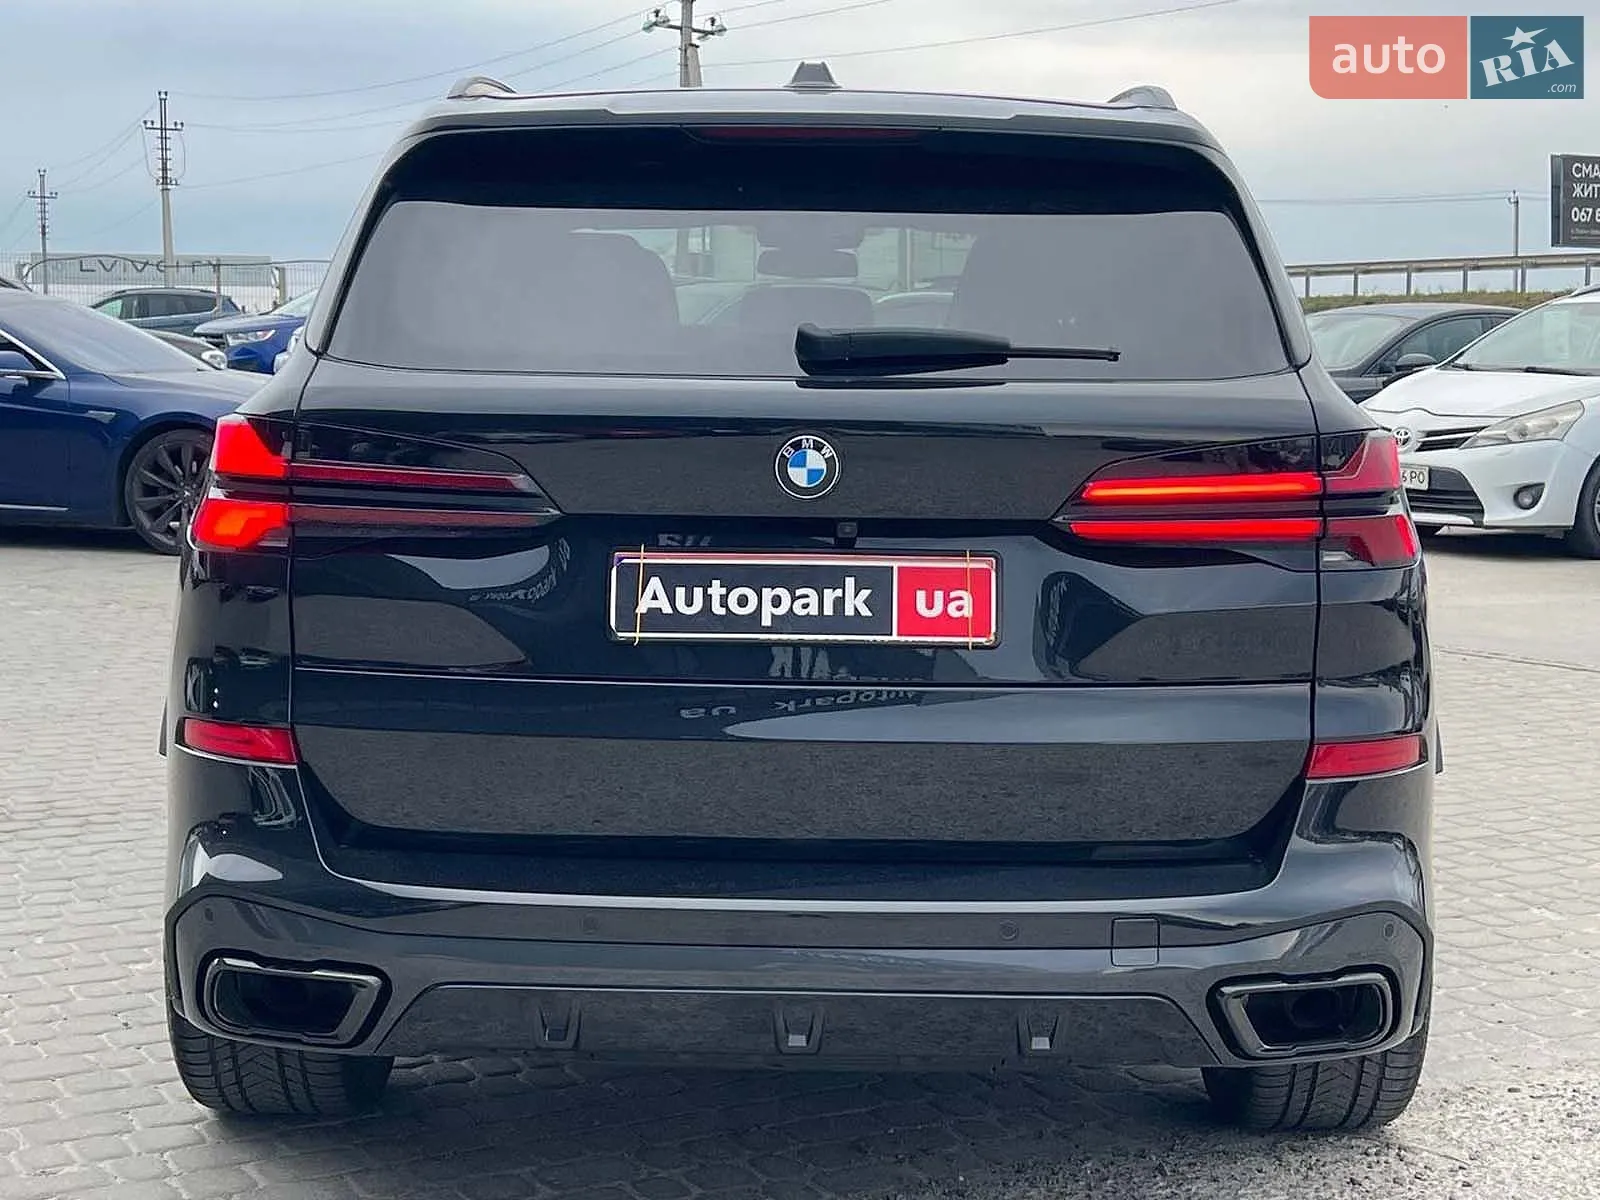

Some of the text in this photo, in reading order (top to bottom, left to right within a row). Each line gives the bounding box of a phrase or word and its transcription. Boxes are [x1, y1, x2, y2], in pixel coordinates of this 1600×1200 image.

[1571, 206, 1593, 222] 067
[782, 438, 833, 459] BMW
[636, 576, 973, 626] Autopark ua
